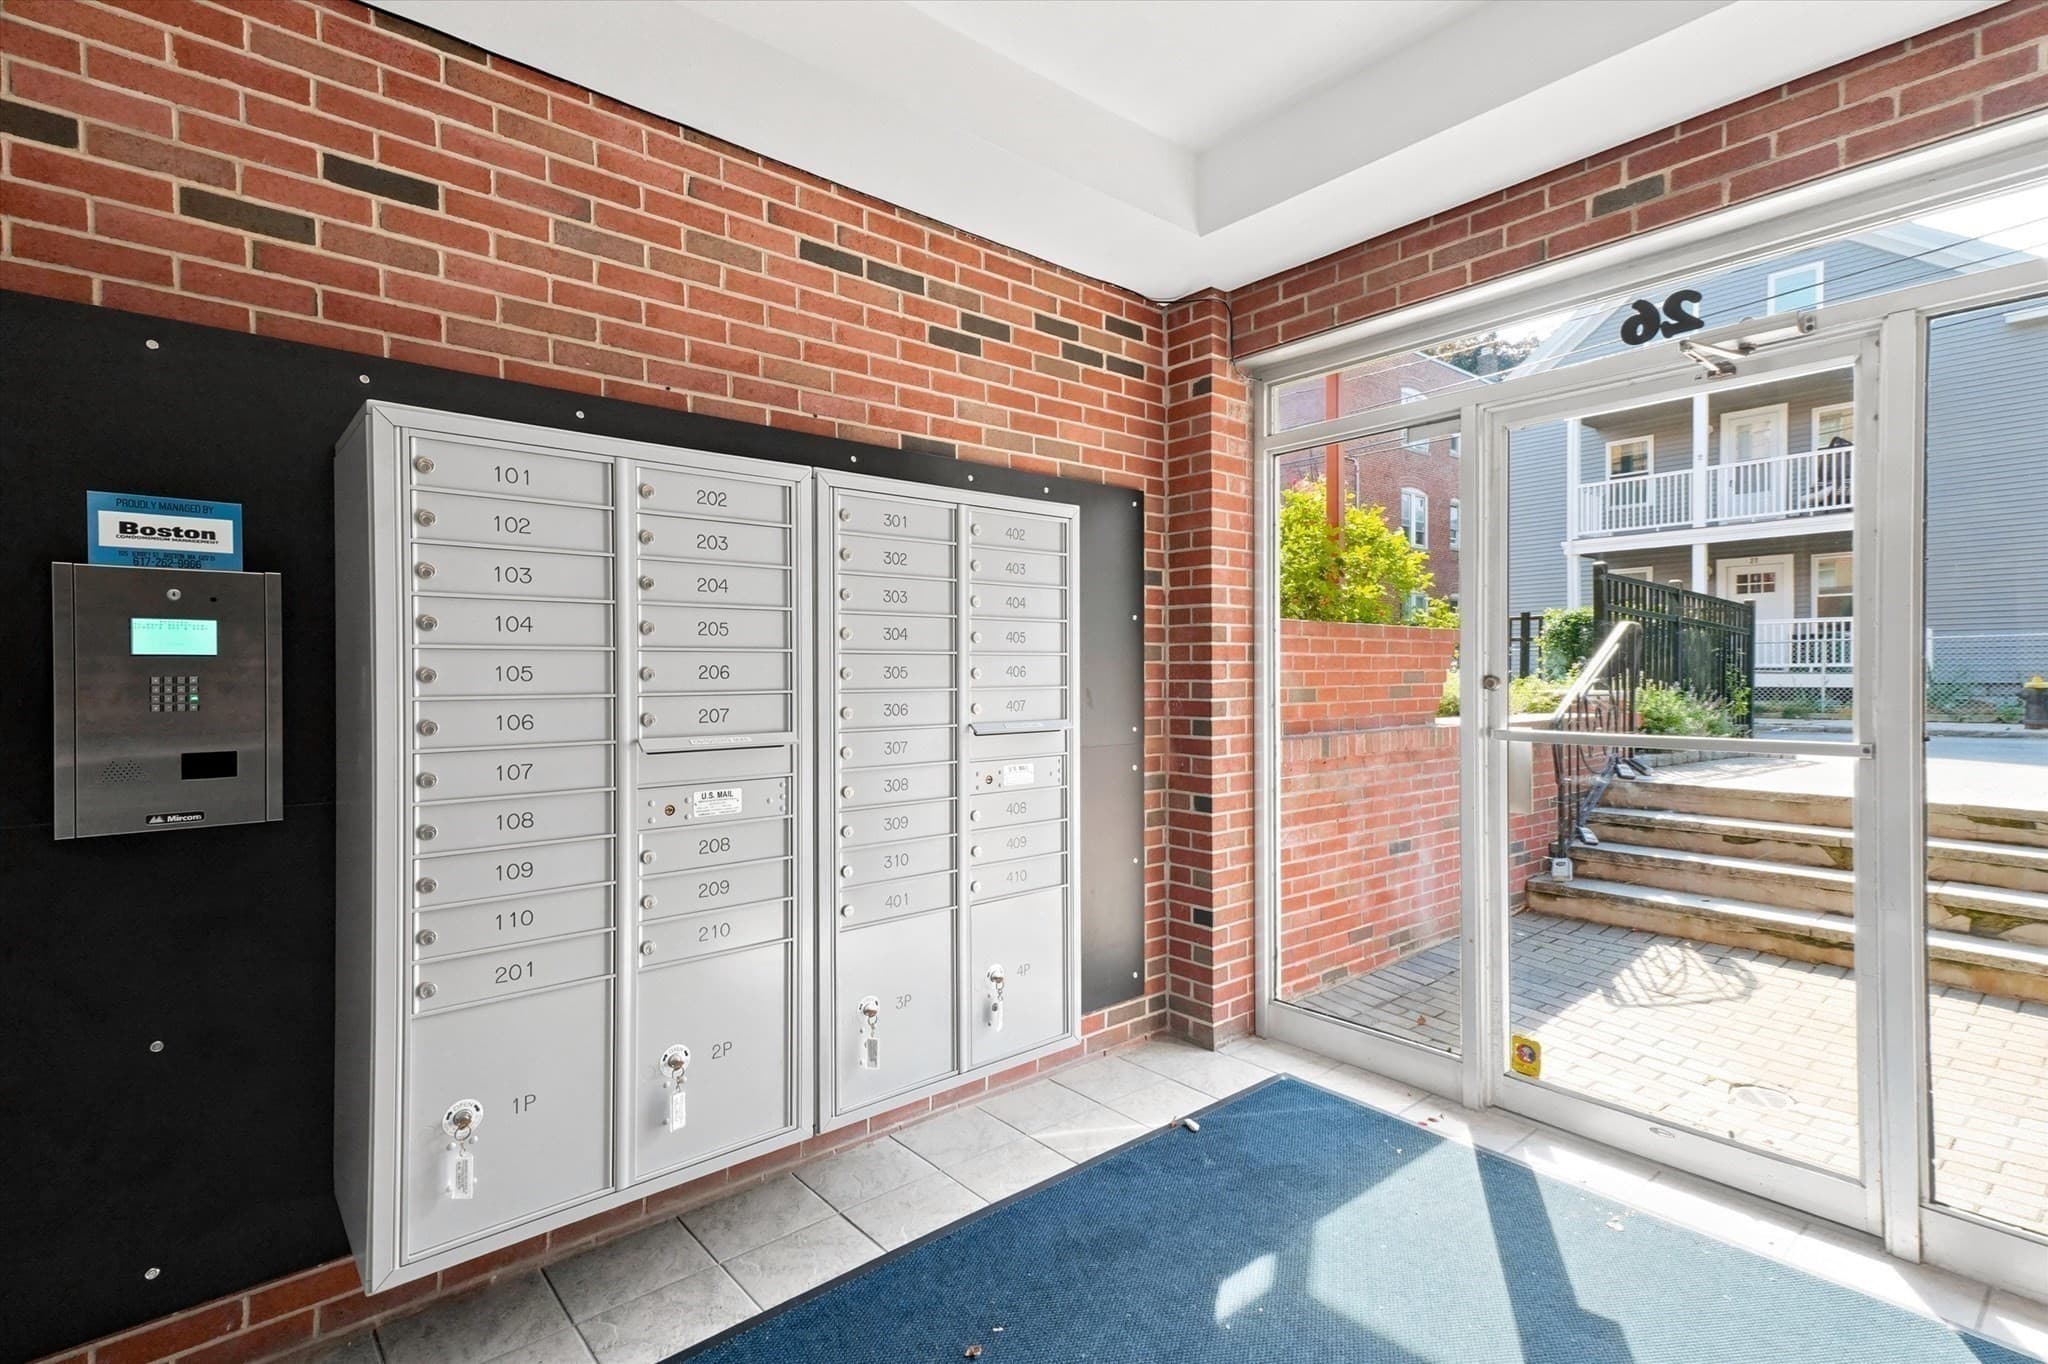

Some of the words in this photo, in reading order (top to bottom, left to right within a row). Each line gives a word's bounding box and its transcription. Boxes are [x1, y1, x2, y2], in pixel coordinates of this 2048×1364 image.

[494, 465, 529, 486] 101
[116, 498, 157, 509] PROUDLY
[159, 502, 201, 513] MANAGED
[203, 505, 214, 514] BY
[696, 489, 728, 508] 202
[494, 515, 532, 535] 102
[883, 513, 907, 529] 301
[118, 521, 216, 541] Boston
[1004, 527, 1026, 542] 402
[696, 533, 729, 551] 203
[883, 551, 908, 567] 302
[494, 565, 533, 585] 103
[1004, 561, 1026, 576] 403
[696, 577, 729, 593] 204
[882, 589, 908, 604] 303
[1005, 596, 1026, 609] 404
[495, 615, 534, 633] 104
[697, 620, 729, 637] 205
[883, 626, 908, 641] 304
[1005, 631, 1026, 644] 405
[495, 665, 534, 682] 105
[698, 664, 730, 680] 206
[883, 665, 909, 680] 305
[1005, 665, 1027, 678] 406
[883, 703, 909, 717] 306
[1005, 699, 1027, 713] 407
[496, 713, 535, 731] 106
[698, 707, 730, 724] 207
[883, 740, 909, 756] 307
[496, 763, 534, 782] 107
[883, 777, 909, 793] 308
[717, 790, 734, 799] MAIL
[1005, 801, 1028, 816] 408
[167, 814, 203, 823] Mircom
[496, 811, 535, 831] 108
[883, 815, 909, 832] 309
[698, 836, 731, 855] 208
[1005, 835, 1028, 849] 409
[883, 852, 909, 869] 310
[495, 861, 534, 881] 109
[1005, 869, 1028, 882] 410
[698, 879, 730, 899] 209
[884, 892, 909, 909] 401
[495, 909, 534, 931] 110
[698, 922, 731, 943] 210
[495, 960, 533, 984] 201
[1016, 962, 1031, 977] 4P
[895, 993, 912, 1010] 3P
[711, 1041, 733, 1060] 2P
[512, 1094, 537, 1115] 1P
